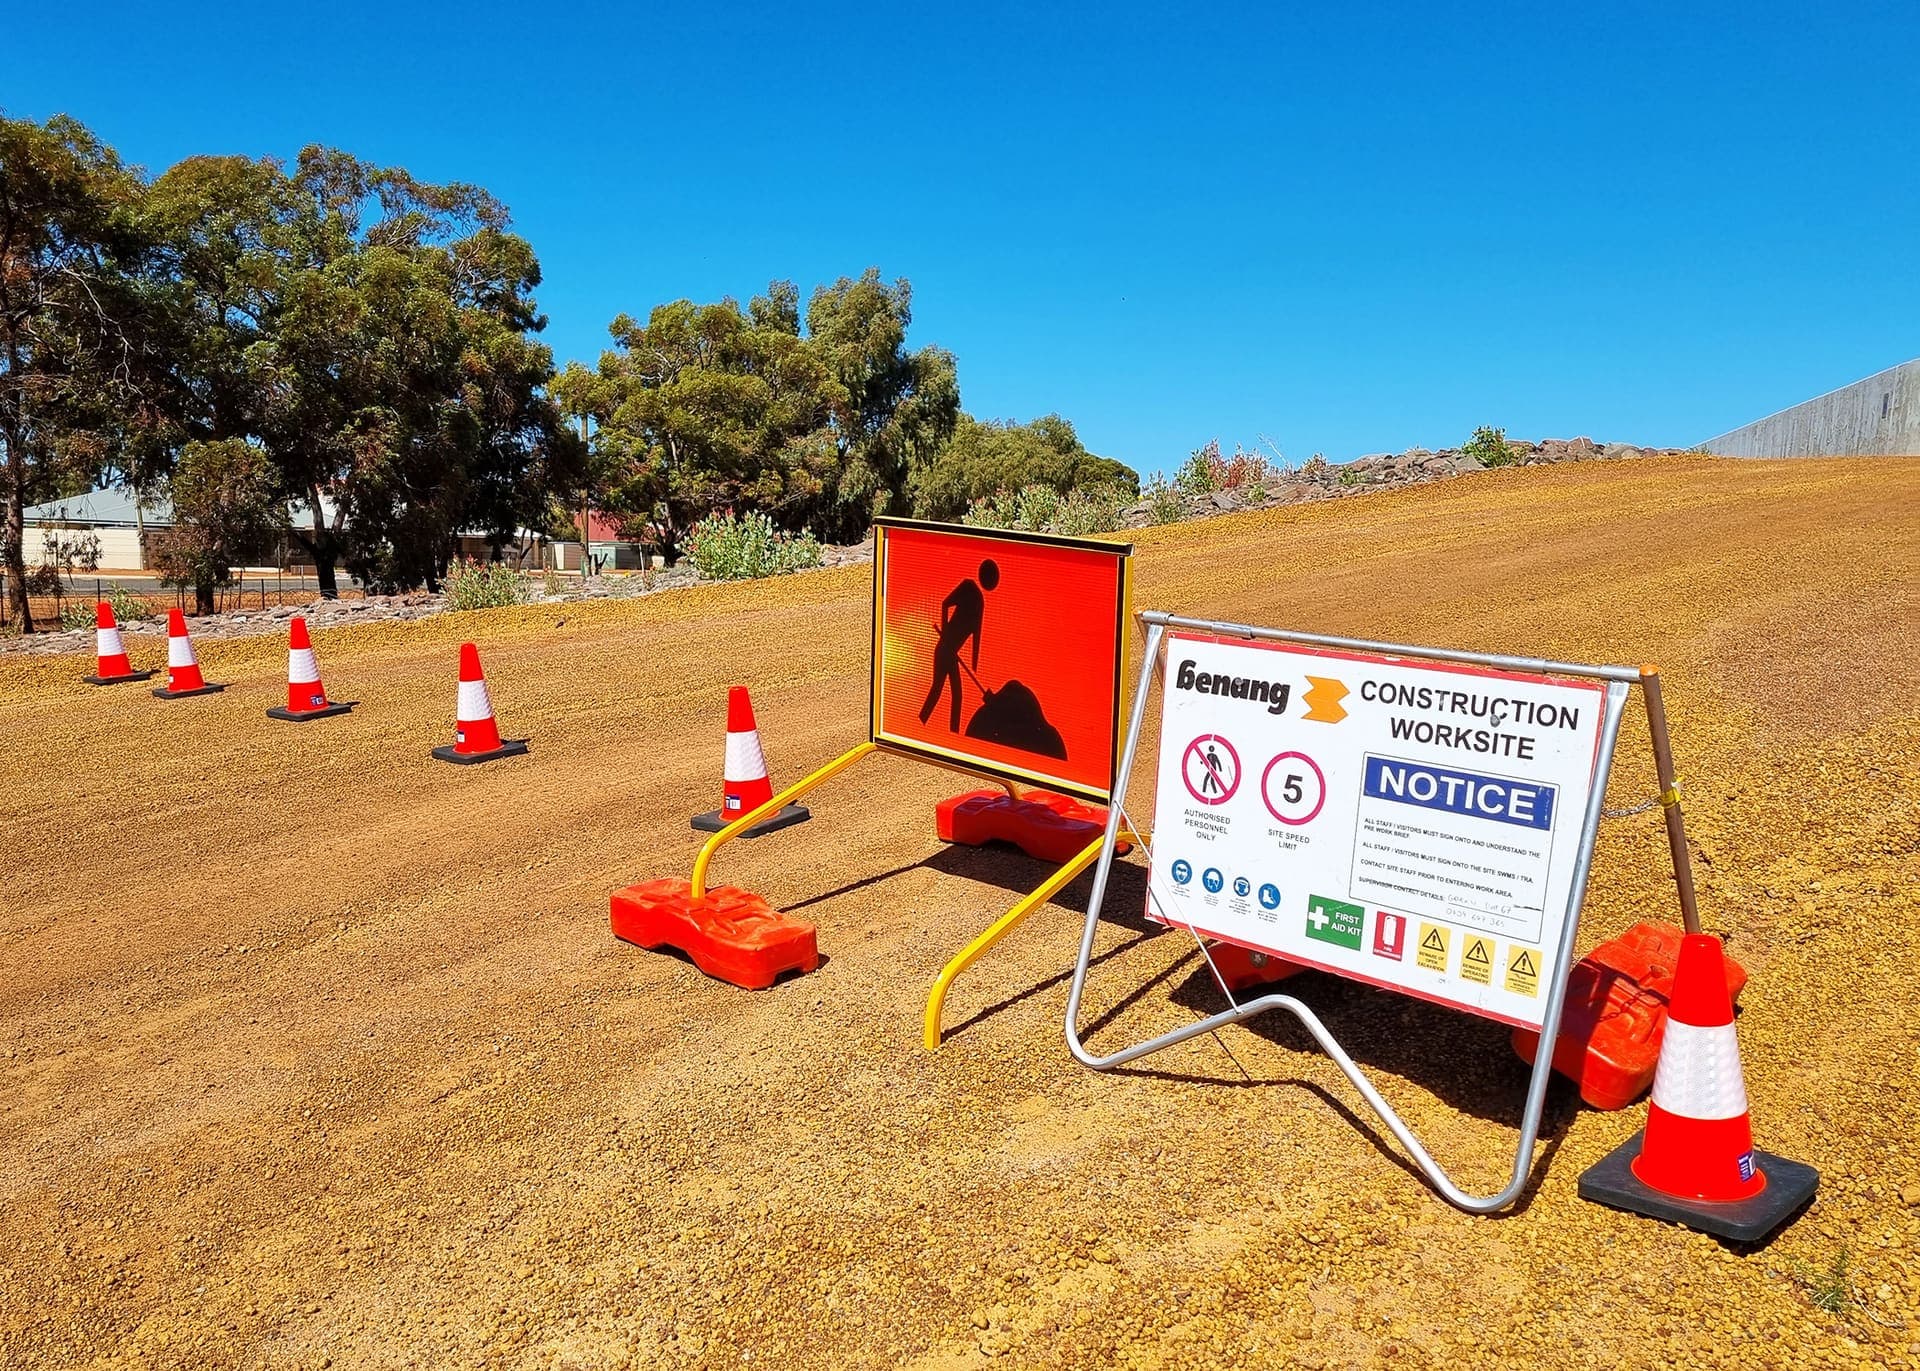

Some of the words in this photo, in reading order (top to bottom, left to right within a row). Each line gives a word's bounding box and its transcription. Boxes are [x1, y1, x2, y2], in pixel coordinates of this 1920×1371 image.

[1176, 659, 1291, 715] benang
[1360, 680, 1579, 731] CONSTRUCTION
[1390, 717, 1535, 760] WORKSITE
[1283, 774, 1303, 804] 5
[1379, 765, 1537, 821] NOTICE
[1184, 808, 1231, 825] AUTHORISED
[1185, 818, 1229, 835] PERSONNEL
[1196, 831, 1216, 841] ONLY
[1268, 828, 1284, 839] SITE
[1286, 832, 1310, 844] SPEED
[1364, 824, 1374, 832] PRE
[1376, 827, 1392, 836] WORK
[1376, 819, 1392, 827] STAFF
[1397, 824, 1422, 834] VISITORS
[1423, 829, 1439, 837] MUST
[1454, 835, 1471, 844] ONTO
[1472, 839, 1485, 847] AND
[1486, 842, 1527, 856] UNDERSTAND
[1529, 850, 1541, 858] THE
[1278, 841, 1297, 851] LIMIT
[1374, 843, 1390, 852] STAFF
[1395, 847, 1419, 859] VISITORS
[1438, 857, 1451, 865] SIGN
[1452, 860, 1469, 869] ONTO
[1470, 864, 1481, 872] THE
[1483, 867, 1496, 875] SITE
[1497, 870, 1516, 880] SWMS
[1361, 858, 1386, 869] CONTACT
[1387, 864, 1398, 872] SITE
[1400, 867, 1416, 876] STAFF
[1418, 871, 1435, 880] PRIOR
[1436, 875, 1444, 883] TO
[1445, 878, 1474, 889] ENTERING
[1476, 884, 1494, 894] WORK
[1331, 923, 1347, 933] AID
[1347, 925, 1362, 937] KIT
[1335, 912, 1360, 925] FIRST
